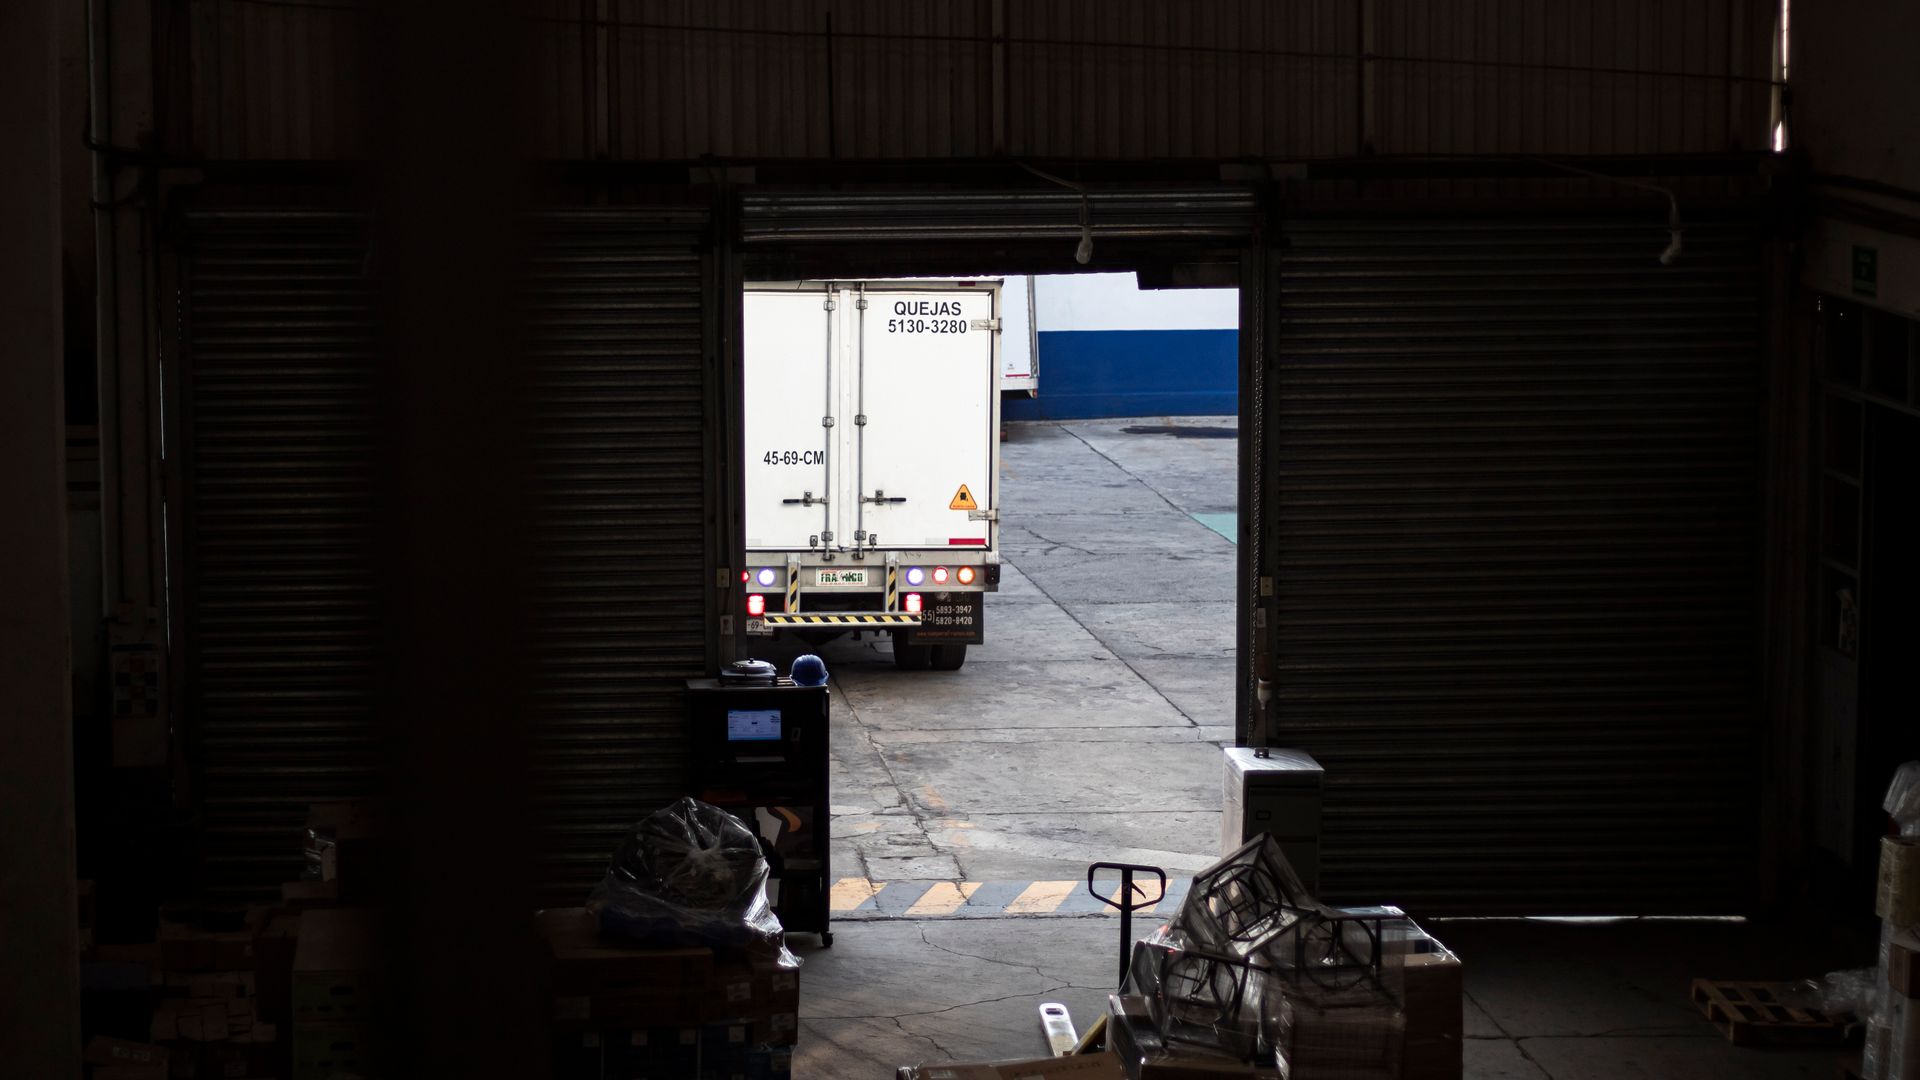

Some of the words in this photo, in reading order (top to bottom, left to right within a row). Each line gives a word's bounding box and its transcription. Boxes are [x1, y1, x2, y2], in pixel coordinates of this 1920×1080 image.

[894, 301, 962, 316] QUEJAS
[888, 319, 967, 334] 5130-3280
[763, 450, 824, 465] 45-69-CM
